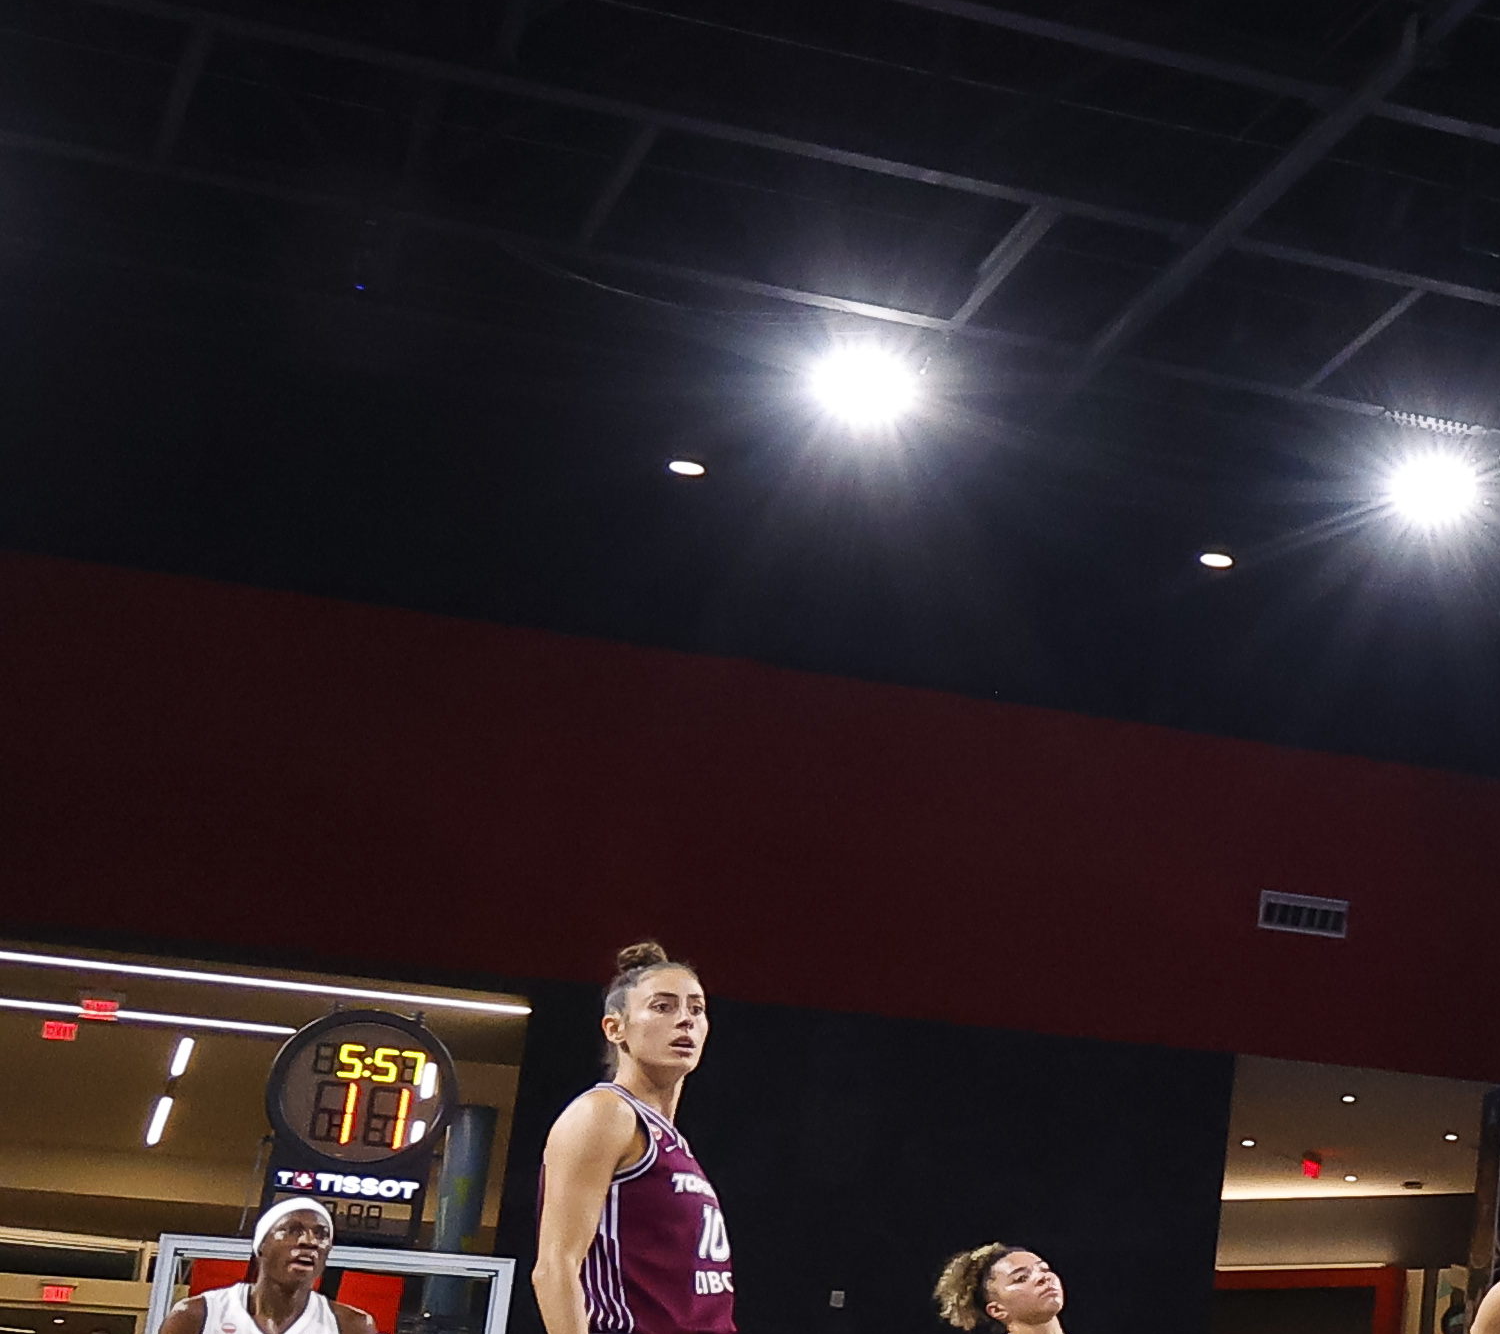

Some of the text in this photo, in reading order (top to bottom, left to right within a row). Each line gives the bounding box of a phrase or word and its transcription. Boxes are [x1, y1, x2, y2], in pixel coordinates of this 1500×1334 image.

[336, 1043, 427, 1087] 5:57
[338, 1081, 413, 1150] 11
[315, 1172, 420, 1199] TISSOT
[698, 1203, 731, 1262] 10
